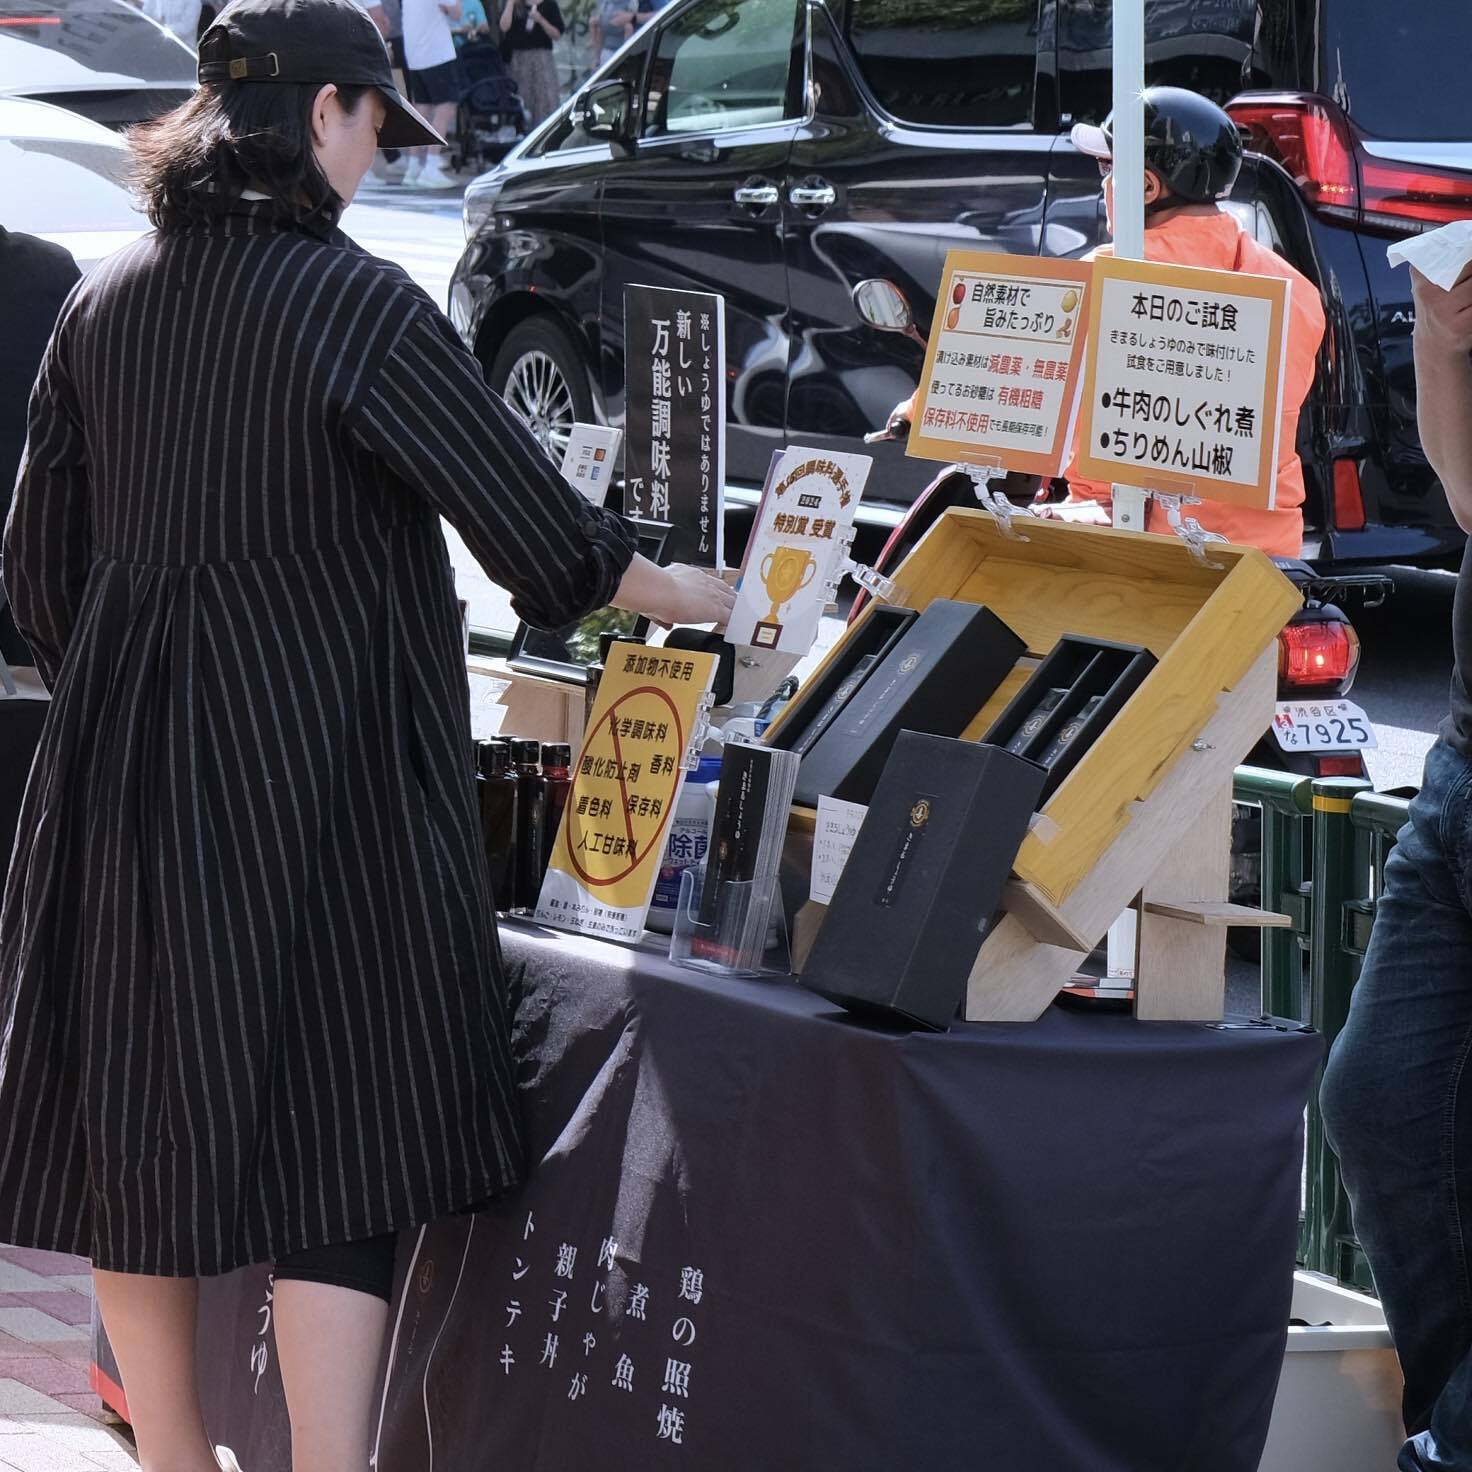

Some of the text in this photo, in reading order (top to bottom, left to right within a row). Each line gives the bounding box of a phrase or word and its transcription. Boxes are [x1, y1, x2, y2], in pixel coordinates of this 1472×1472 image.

[971, 283, 1031, 307] 自然素材で
[984, 308, 1054, 333] 旨みたっぷり
[1131, 292, 1238, 331] 本日のご試食
[676, 309, 692, 397] 新しい
[1110, 330, 1256, 364] きまるしょうゆのみで味付けした
[1126, 354, 1231, 382] 試食をご用意しました！
[650, 319, 671, 521] 万能調味料
[622, 654, 695, 681] 添加物不使用
[1295, 706, 1337, 718] 渋谷区
[608, 715, 668, 743] 化学調味料
[1283, 717, 1369, 745] な 7925
[580, 754, 675, 783] 酸化防止剤 香料
[576, 794, 663, 820] 着色料 保存料
[577, 829, 638, 859] 人工甘味料
[499, 1211, 535, 1375] トンテキ
[540, 1242, 578, 1369] 親子丼
[568, 1235, 618, 1400] 肉じゃが
[611, 1283, 650, 1393] 煮魚
[656, 1265, 704, 1445] 鶏の照焼
